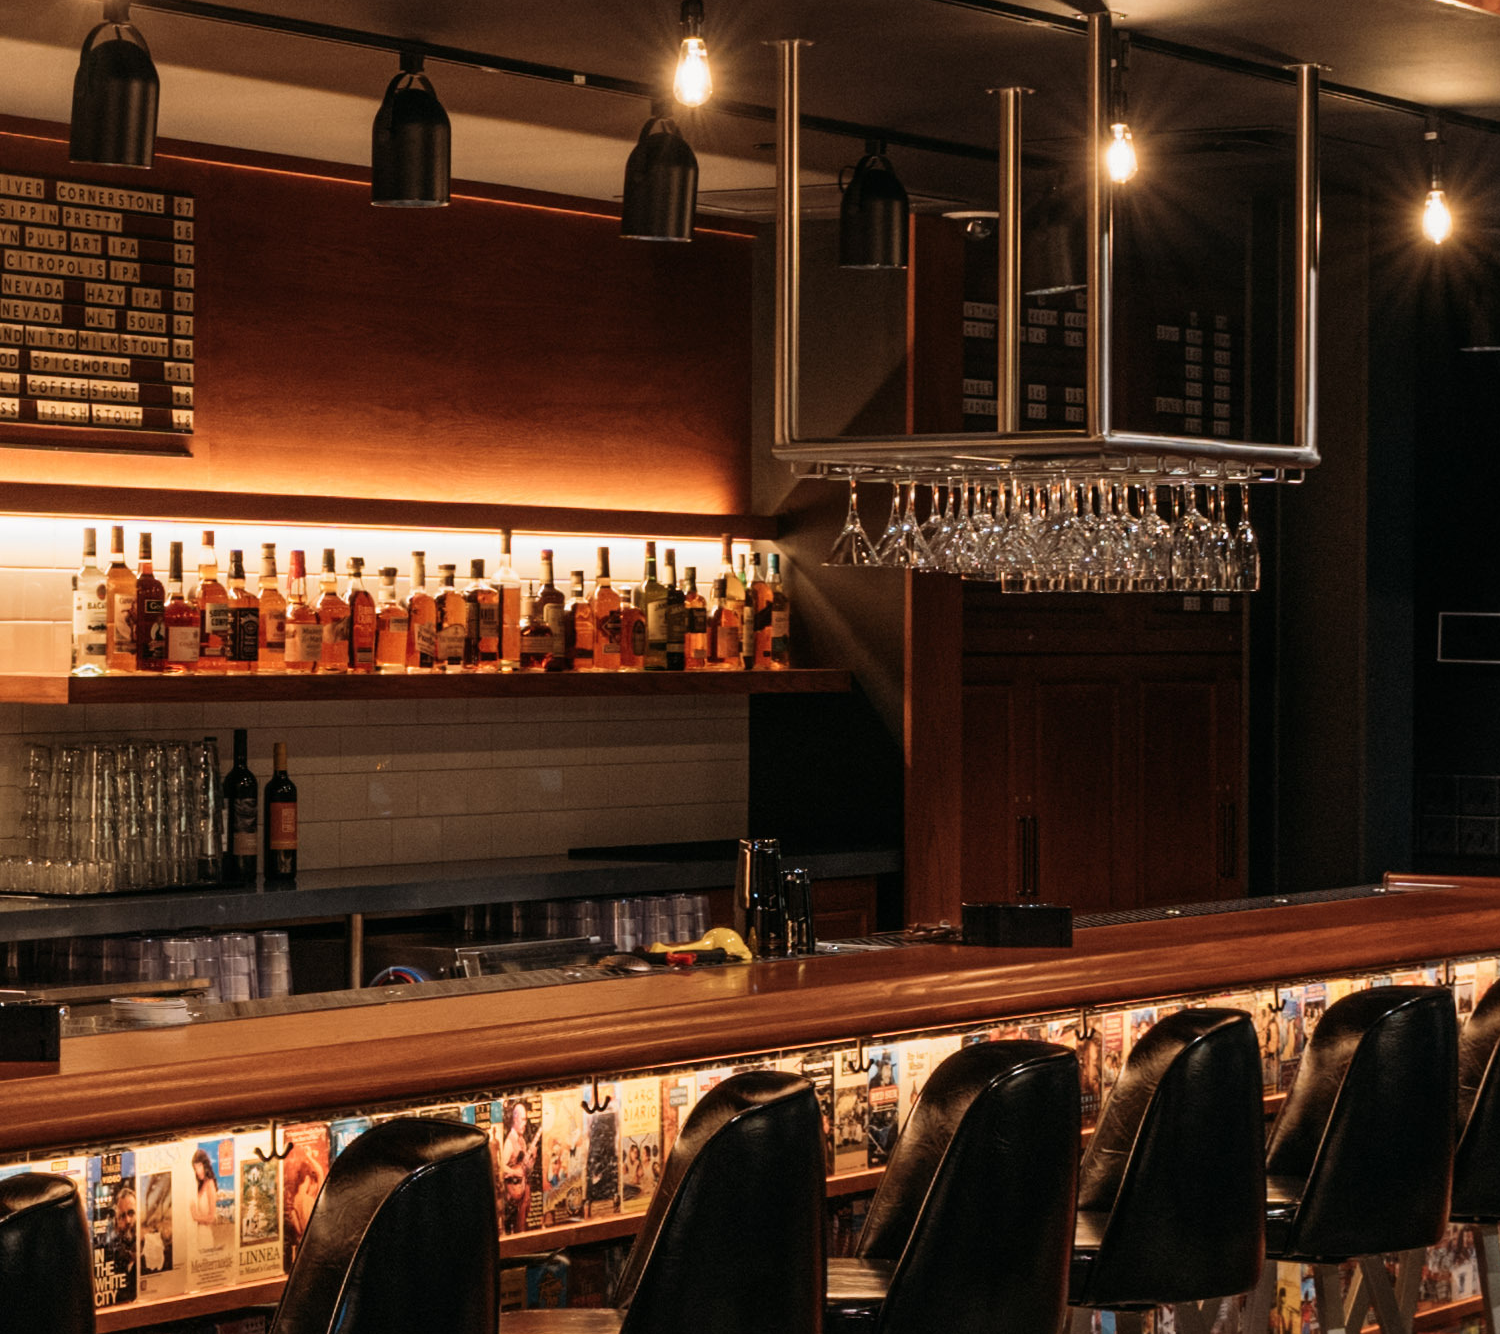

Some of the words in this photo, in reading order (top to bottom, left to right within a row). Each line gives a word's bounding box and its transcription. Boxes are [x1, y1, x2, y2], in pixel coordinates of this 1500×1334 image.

[58, 185, 163, 212] CORNERSTONE
[176, 201, 192, 216] $7
[26, 331, 76, 347] NITRO
[80, 336, 119, 351] MILK
[122, 339, 168, 355] STOUT
[176, 344, 192, 357] $8
[41, 404, 88, 422] IRISH
[95, 409, 141, 427] STOUT
[175, 415, 192, 429] $8
[94, 1247, 105, 1262] IN
[238, 1246, 281, 1267] LINNEA
[94, 1262, 115, 1278] THE
[94, 1273, 127, 1292] WHITE
[94, 1291, 118, 1307] CITY
